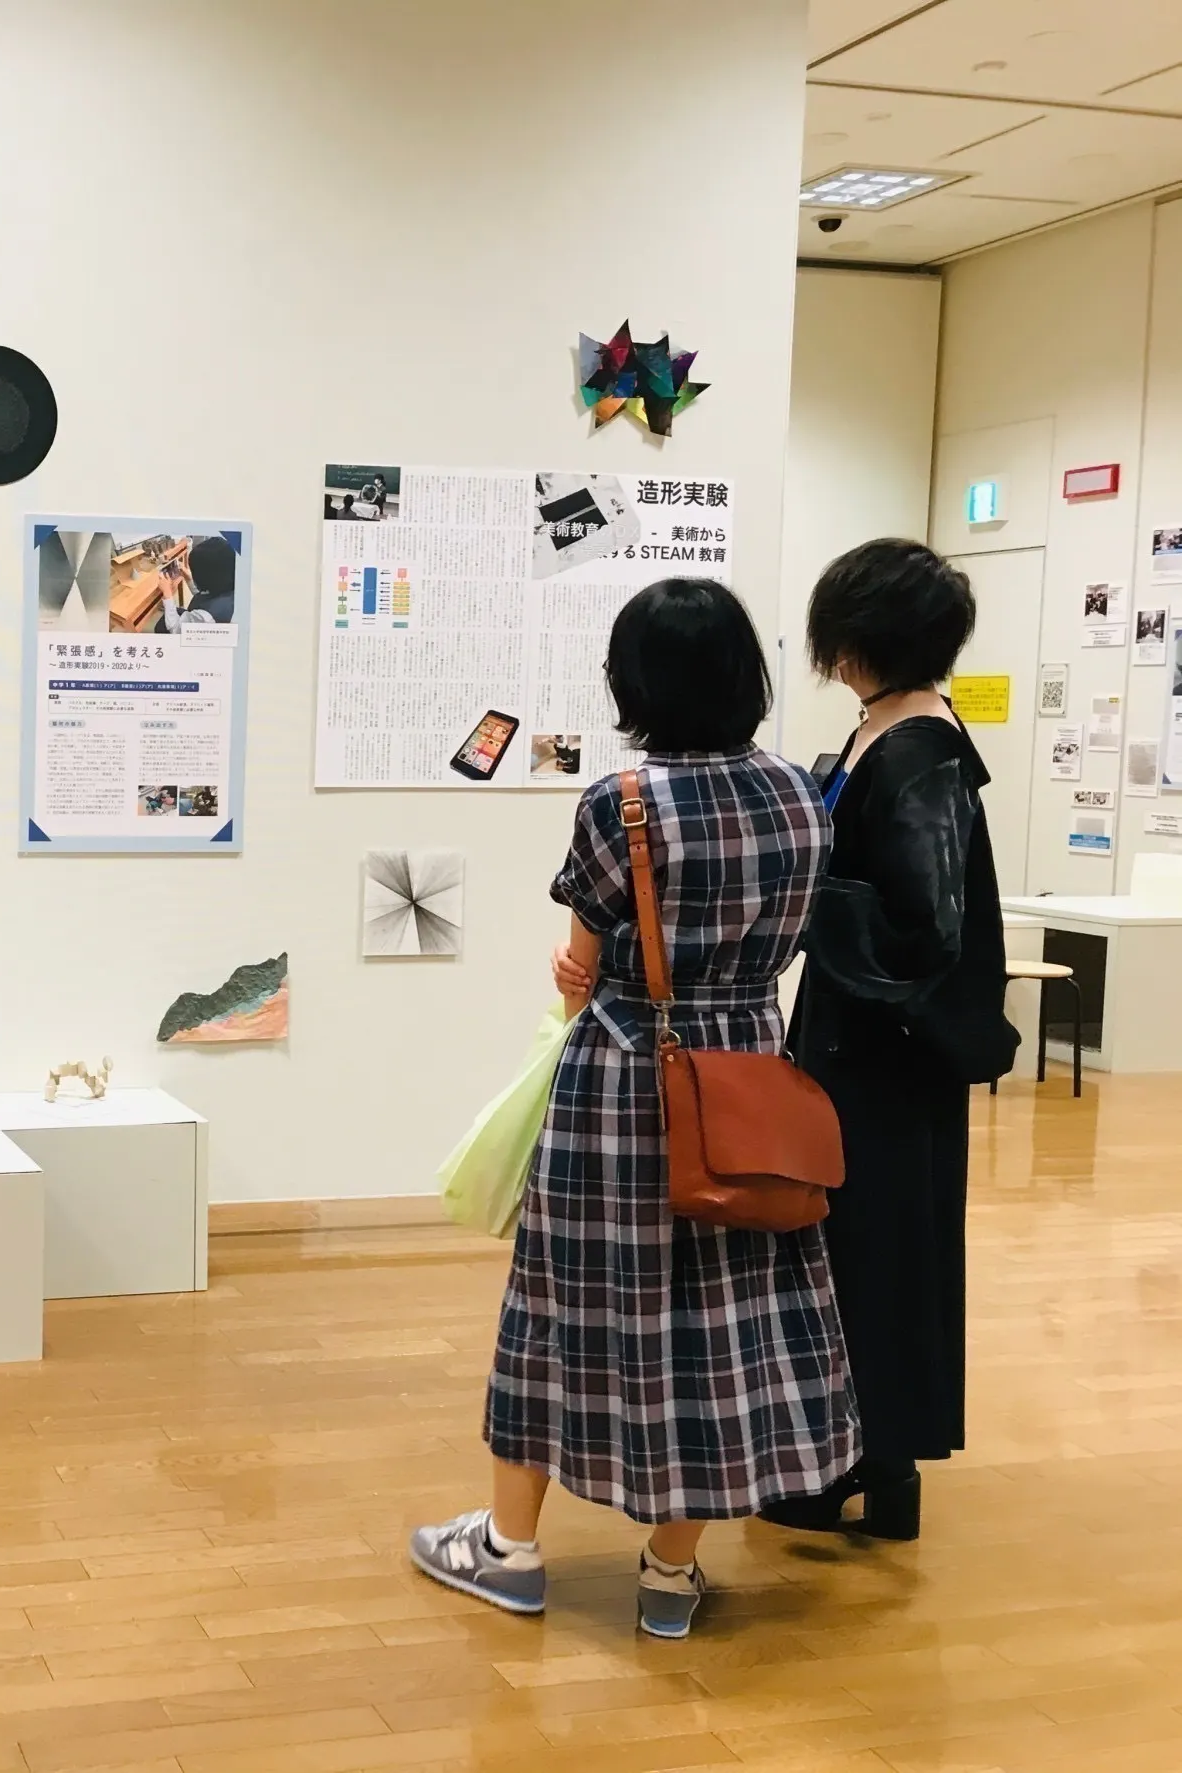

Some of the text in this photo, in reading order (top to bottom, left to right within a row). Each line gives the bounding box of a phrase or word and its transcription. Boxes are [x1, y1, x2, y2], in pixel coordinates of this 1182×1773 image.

[637, 479, 729, 507] 造形実験
[671, 526, 726, 542] 美術から
[640, 547, 694, 560] STEAM
[699, 547, 726, 562] 教育
